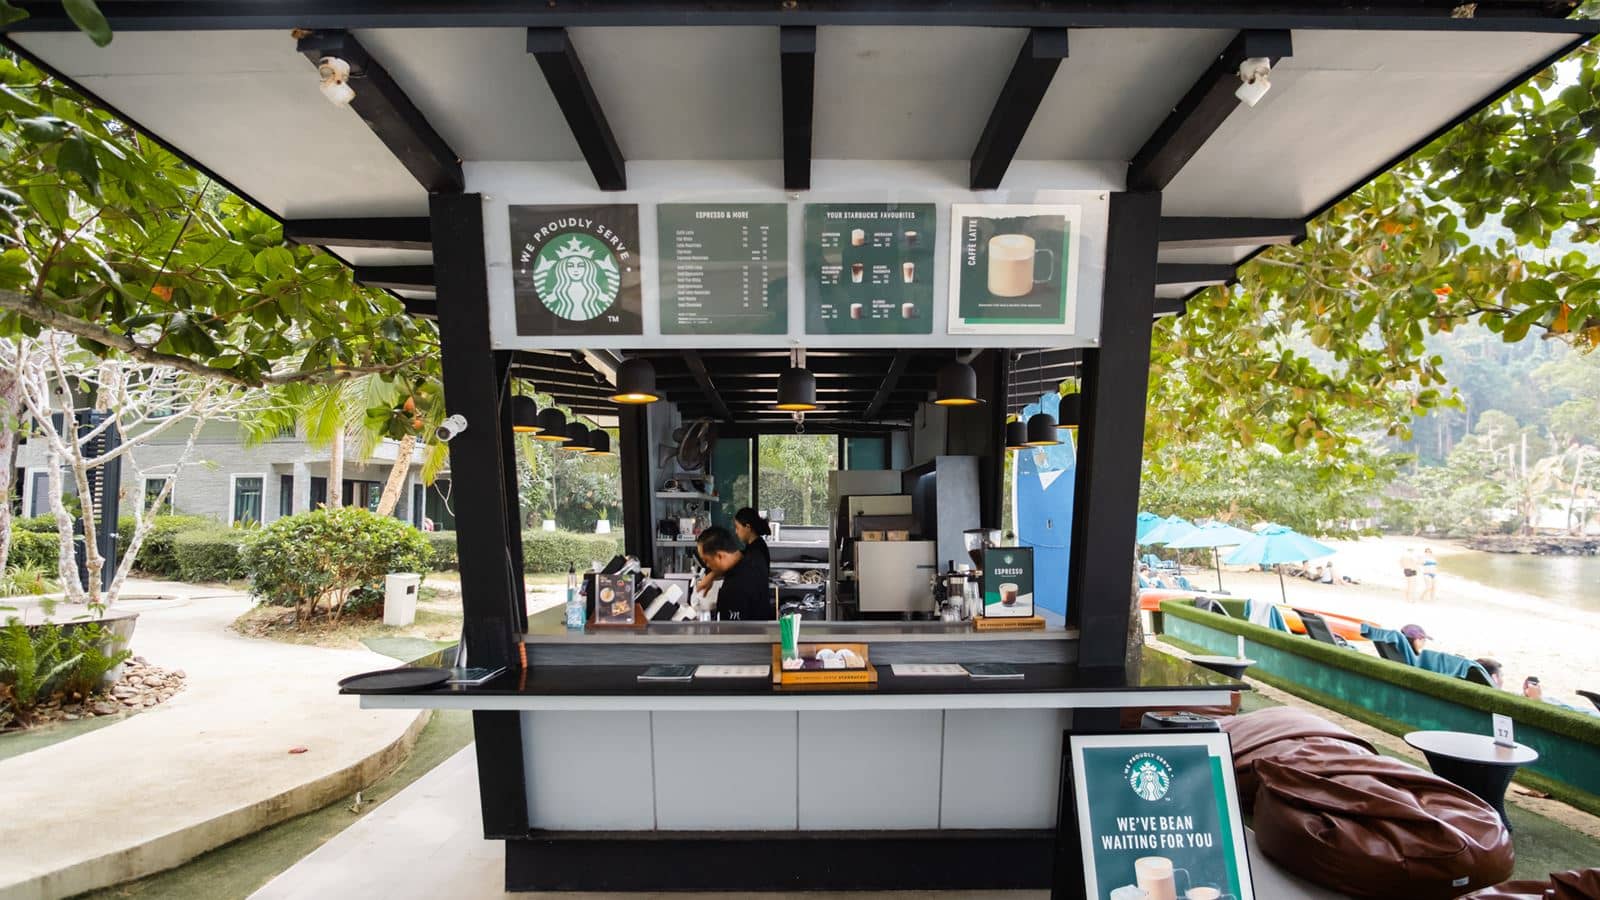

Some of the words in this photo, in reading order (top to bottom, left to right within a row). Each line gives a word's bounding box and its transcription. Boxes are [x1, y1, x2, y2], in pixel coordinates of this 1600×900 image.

[695, 211, 725, 219] ESPRESSO
[726, 211, 731, 219] &
[732, 211, 749, 219] MORE
[826, 211, 842, 219] YOUR
[843, 211, 878, 219] STARBUCKS
[880, 211, 915, 219] FAVOURITES
[968, 220, 978, 242] LATTE
[520, 243, 536, 263] WE
[533, 217, 593, 242] PROUDLY
[596, 224, 630, 260] SERVE
[994, 567, 1023, 575] ESPRESSO
[1129, 752, 1155, 764] PROUDLY
[1116, 816, 1157, 832] WE'VE
[1159, 815, 1193, 831] BEAN
[1101, 834, 1157, 850] WAITING
[1160, 833, 1184, 848] FOR
[1186, 832, 1213, 847] YOU
